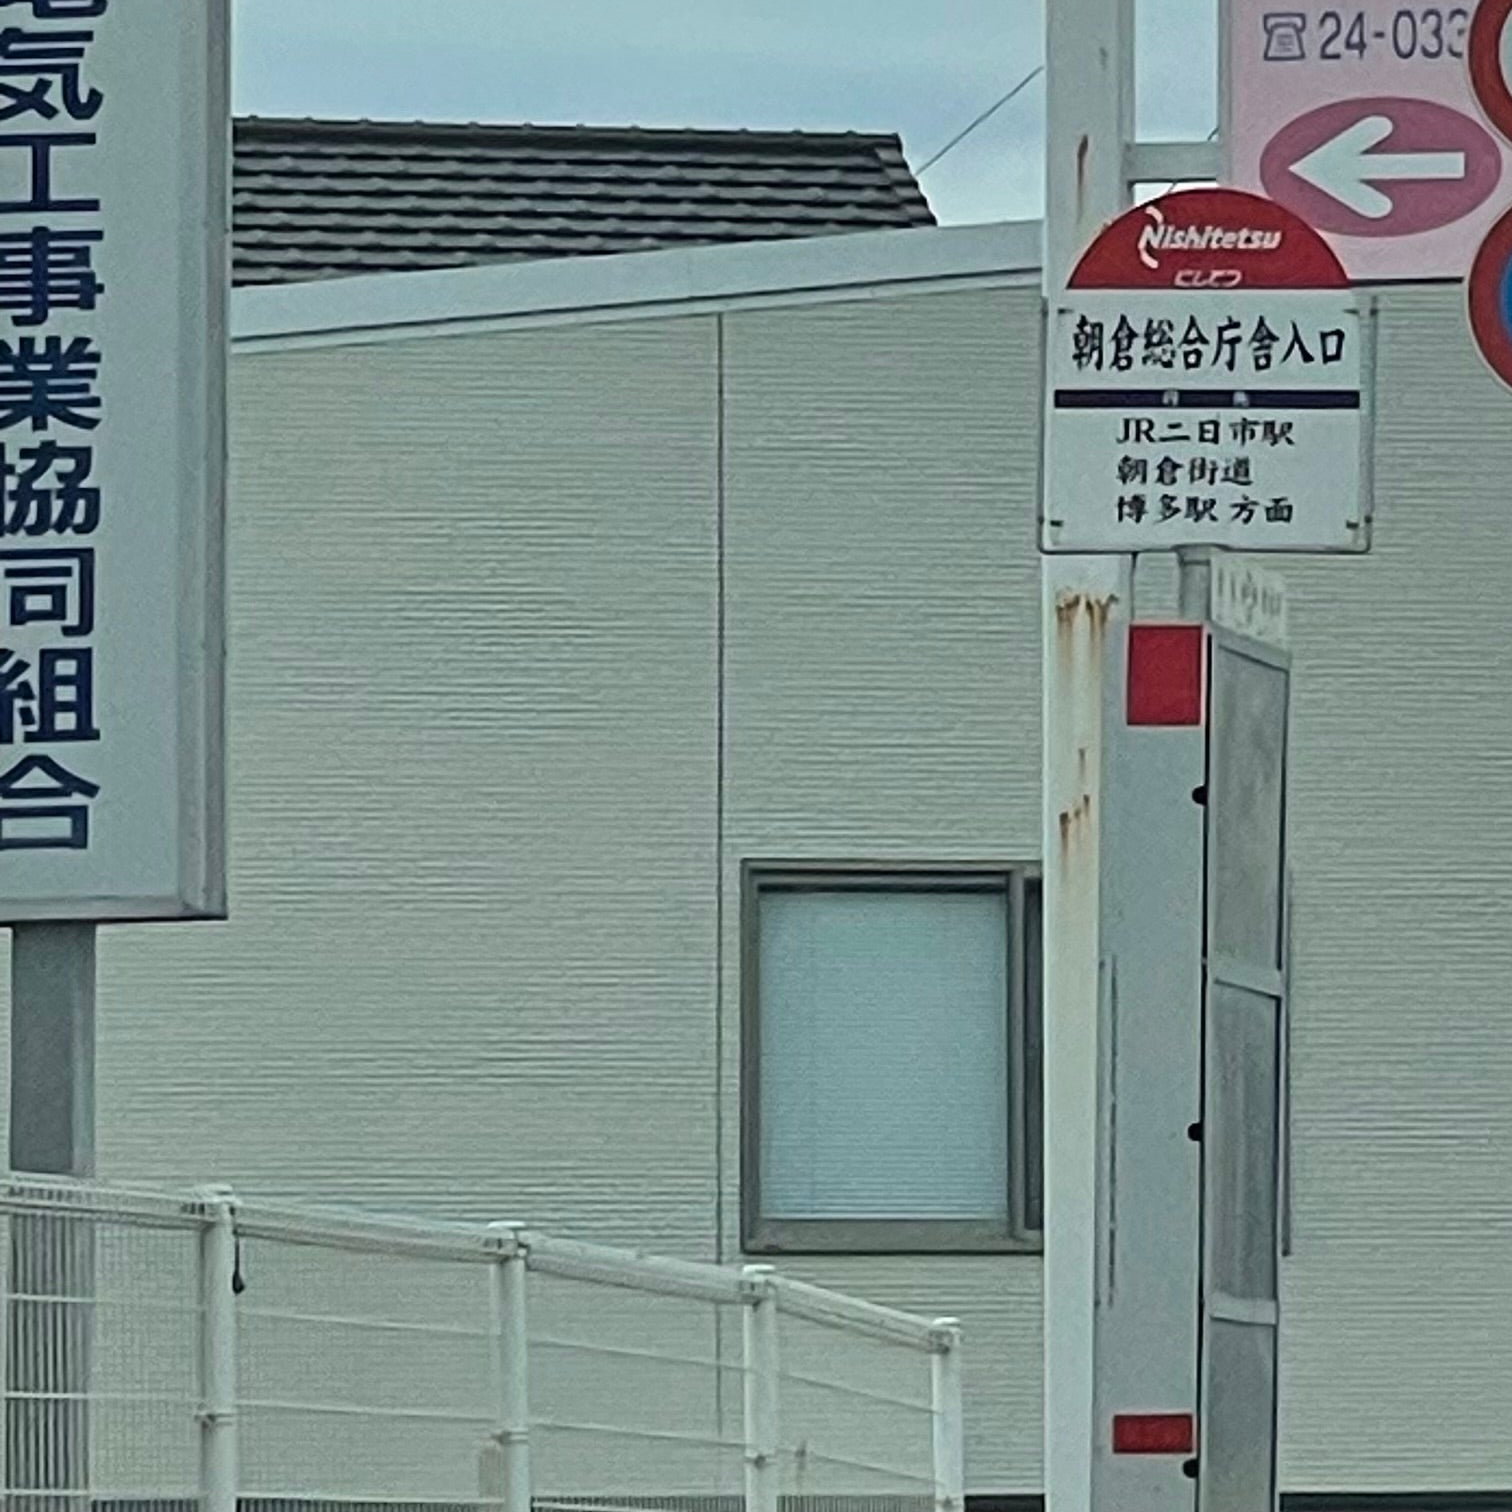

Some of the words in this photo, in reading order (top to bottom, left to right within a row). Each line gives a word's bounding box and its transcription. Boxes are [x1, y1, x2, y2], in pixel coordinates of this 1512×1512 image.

[1138, 206, 1282, 269] Nishitetsu
[1072, 313, 1346, 372] 朝倉総合庁舎入口
[1116, 417, 1295, 447] JR二日市駅
[1117, 455, 1253, 486] 朝倉街道
